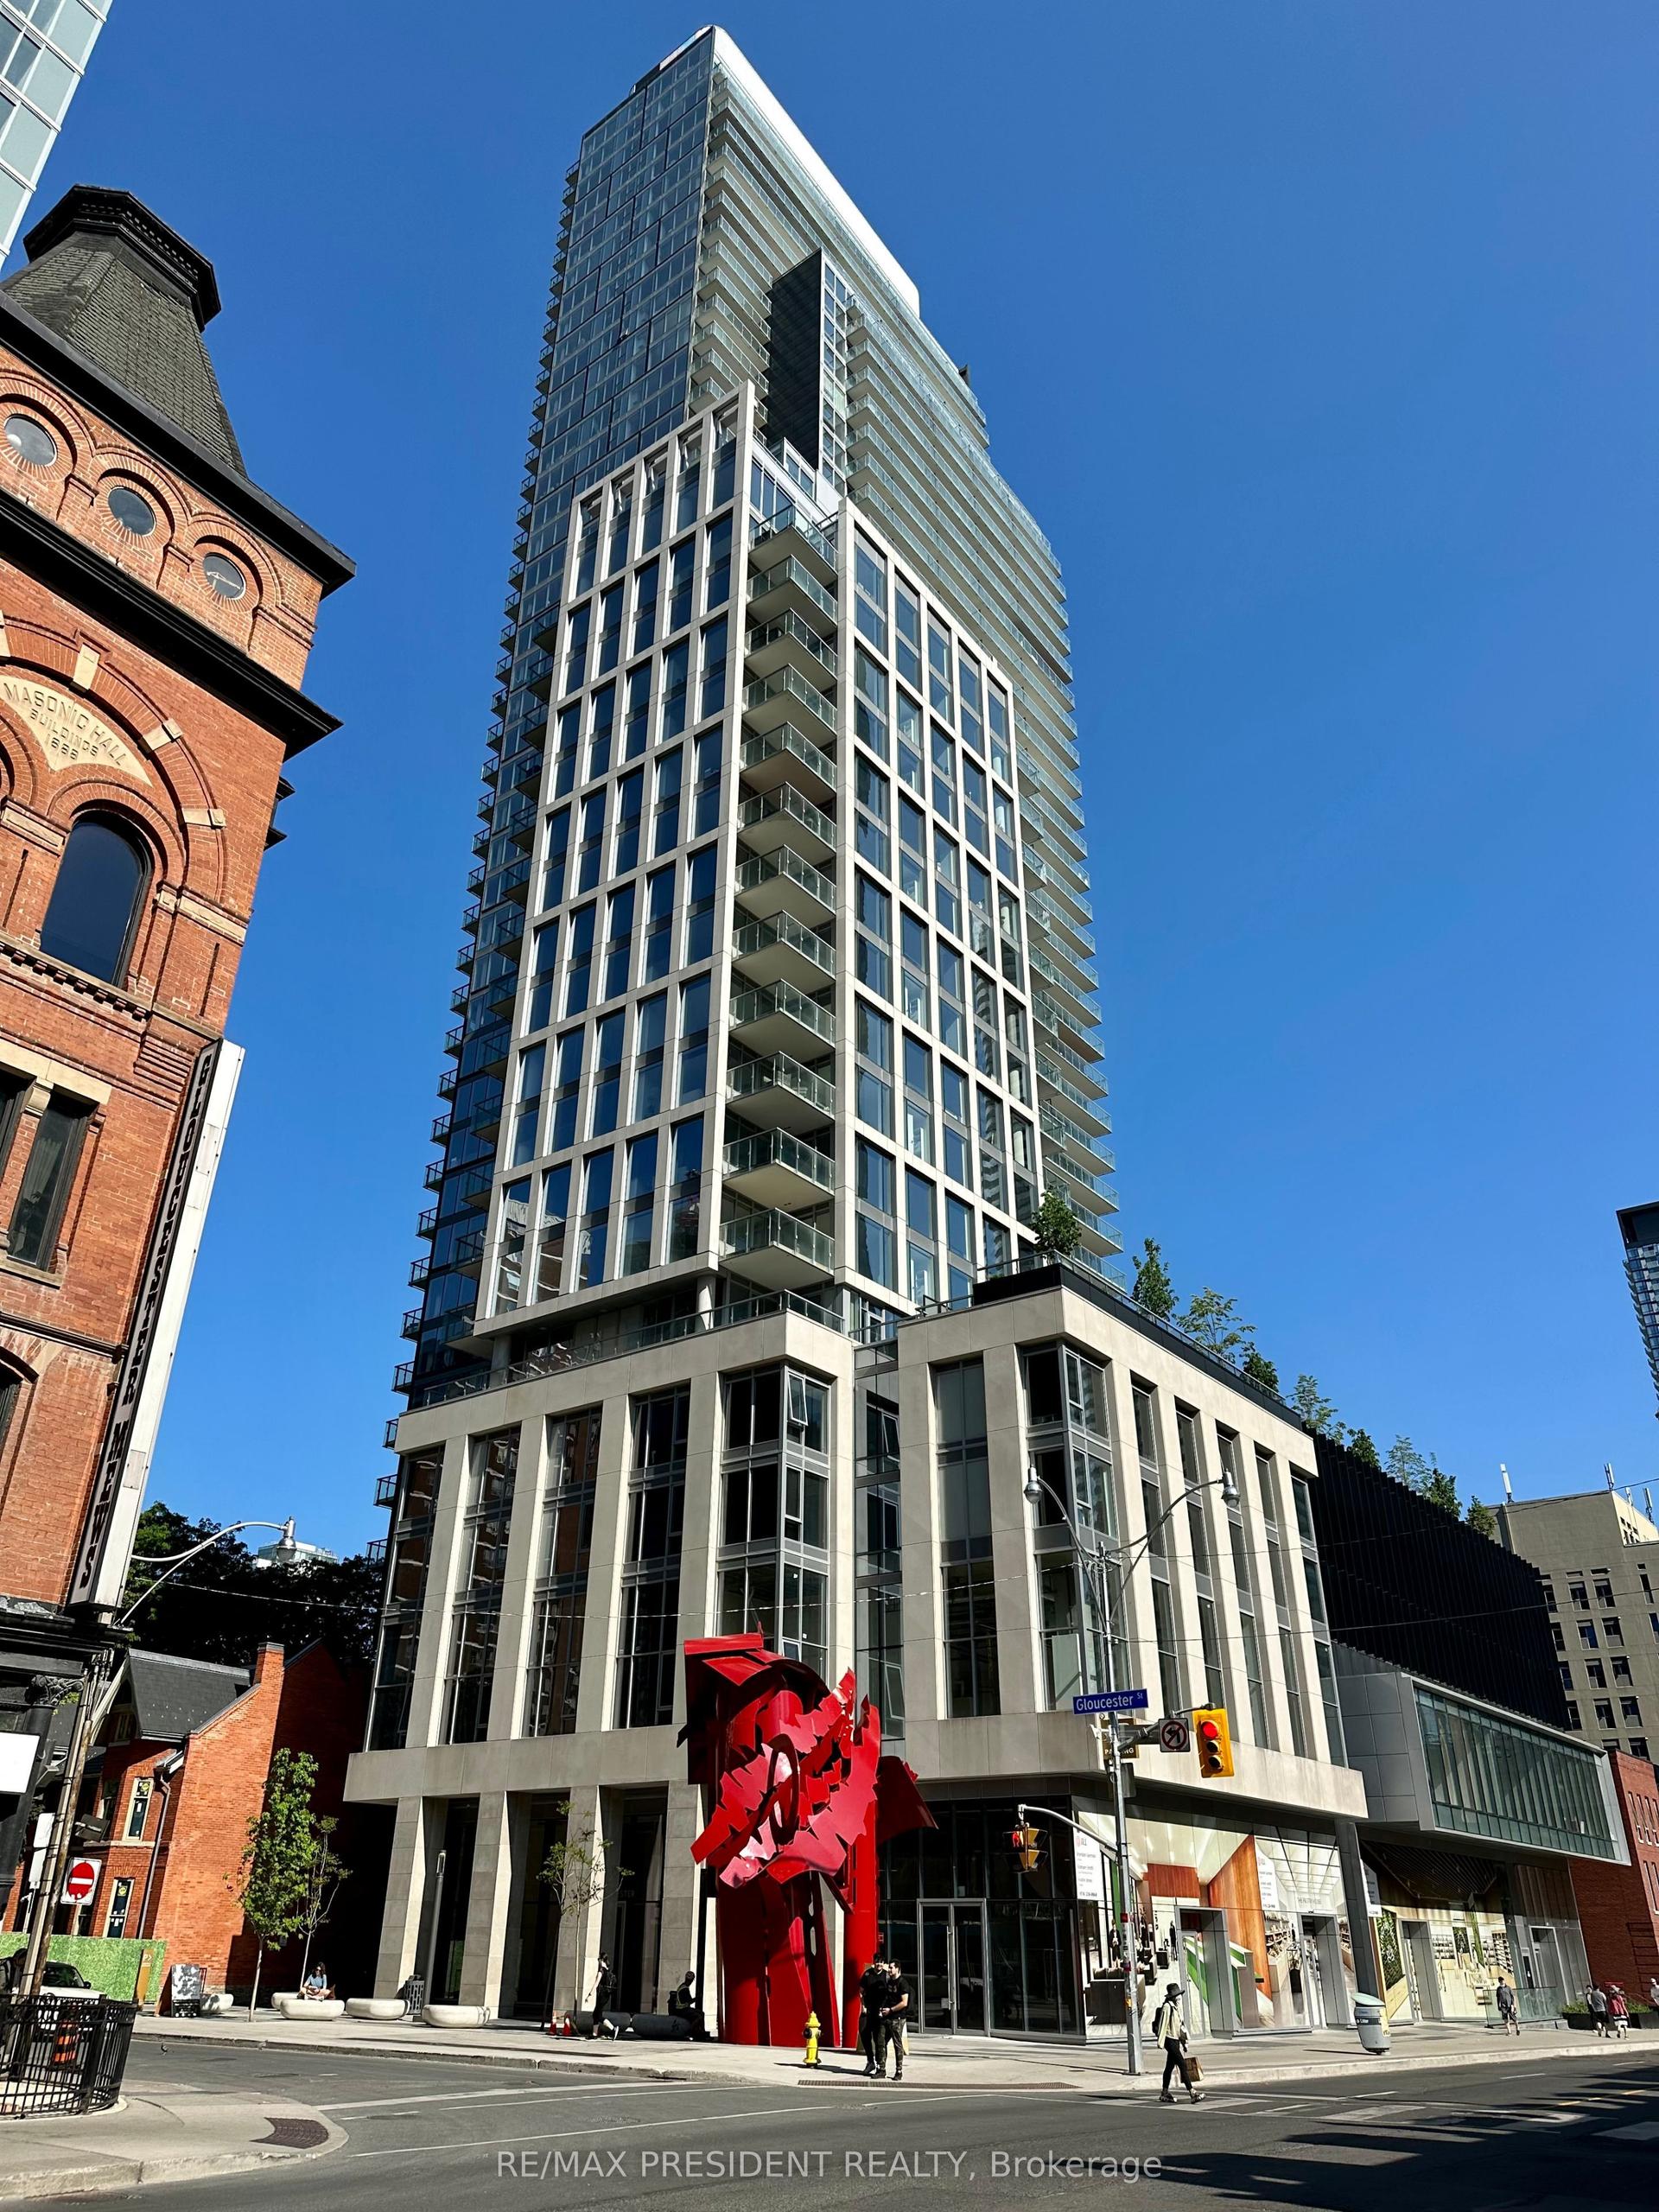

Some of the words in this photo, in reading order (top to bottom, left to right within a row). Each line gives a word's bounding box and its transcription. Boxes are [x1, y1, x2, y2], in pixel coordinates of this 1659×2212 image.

[3, 683, 89, 729] MASONIC
[90, 725, 126, 766] HALL
[29, 709, 99, 757] BUILDINGS
[122, 1053, 212, 1407] GLOUCESTER
[79, 1419, 130, 1590] MEWS
[1076, 1695, 1134, 1711] Gloucester
